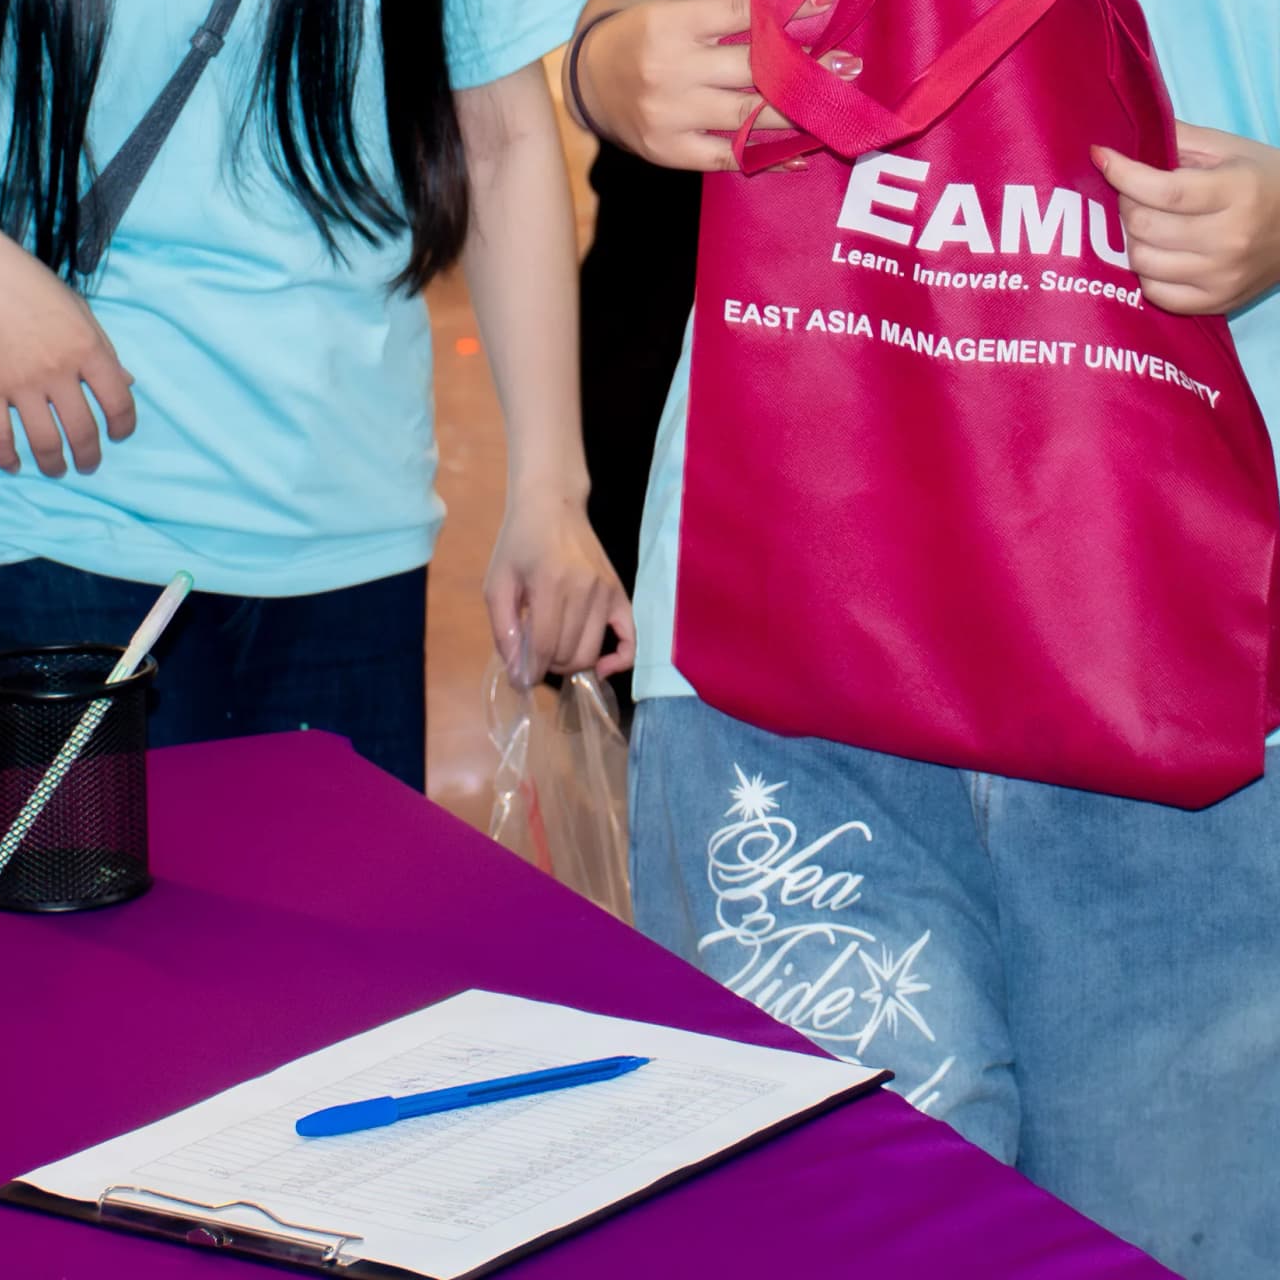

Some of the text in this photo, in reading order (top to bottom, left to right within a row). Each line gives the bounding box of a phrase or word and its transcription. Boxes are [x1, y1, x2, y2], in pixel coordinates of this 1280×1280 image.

[836, 151, 1131, 271] EAMU
[831, 242, 1144, 310] Learn. Innovate. Succeed.
[724, 298, 1220, 409] EAST ASIA MANAGEMENT UNIVERSITY
